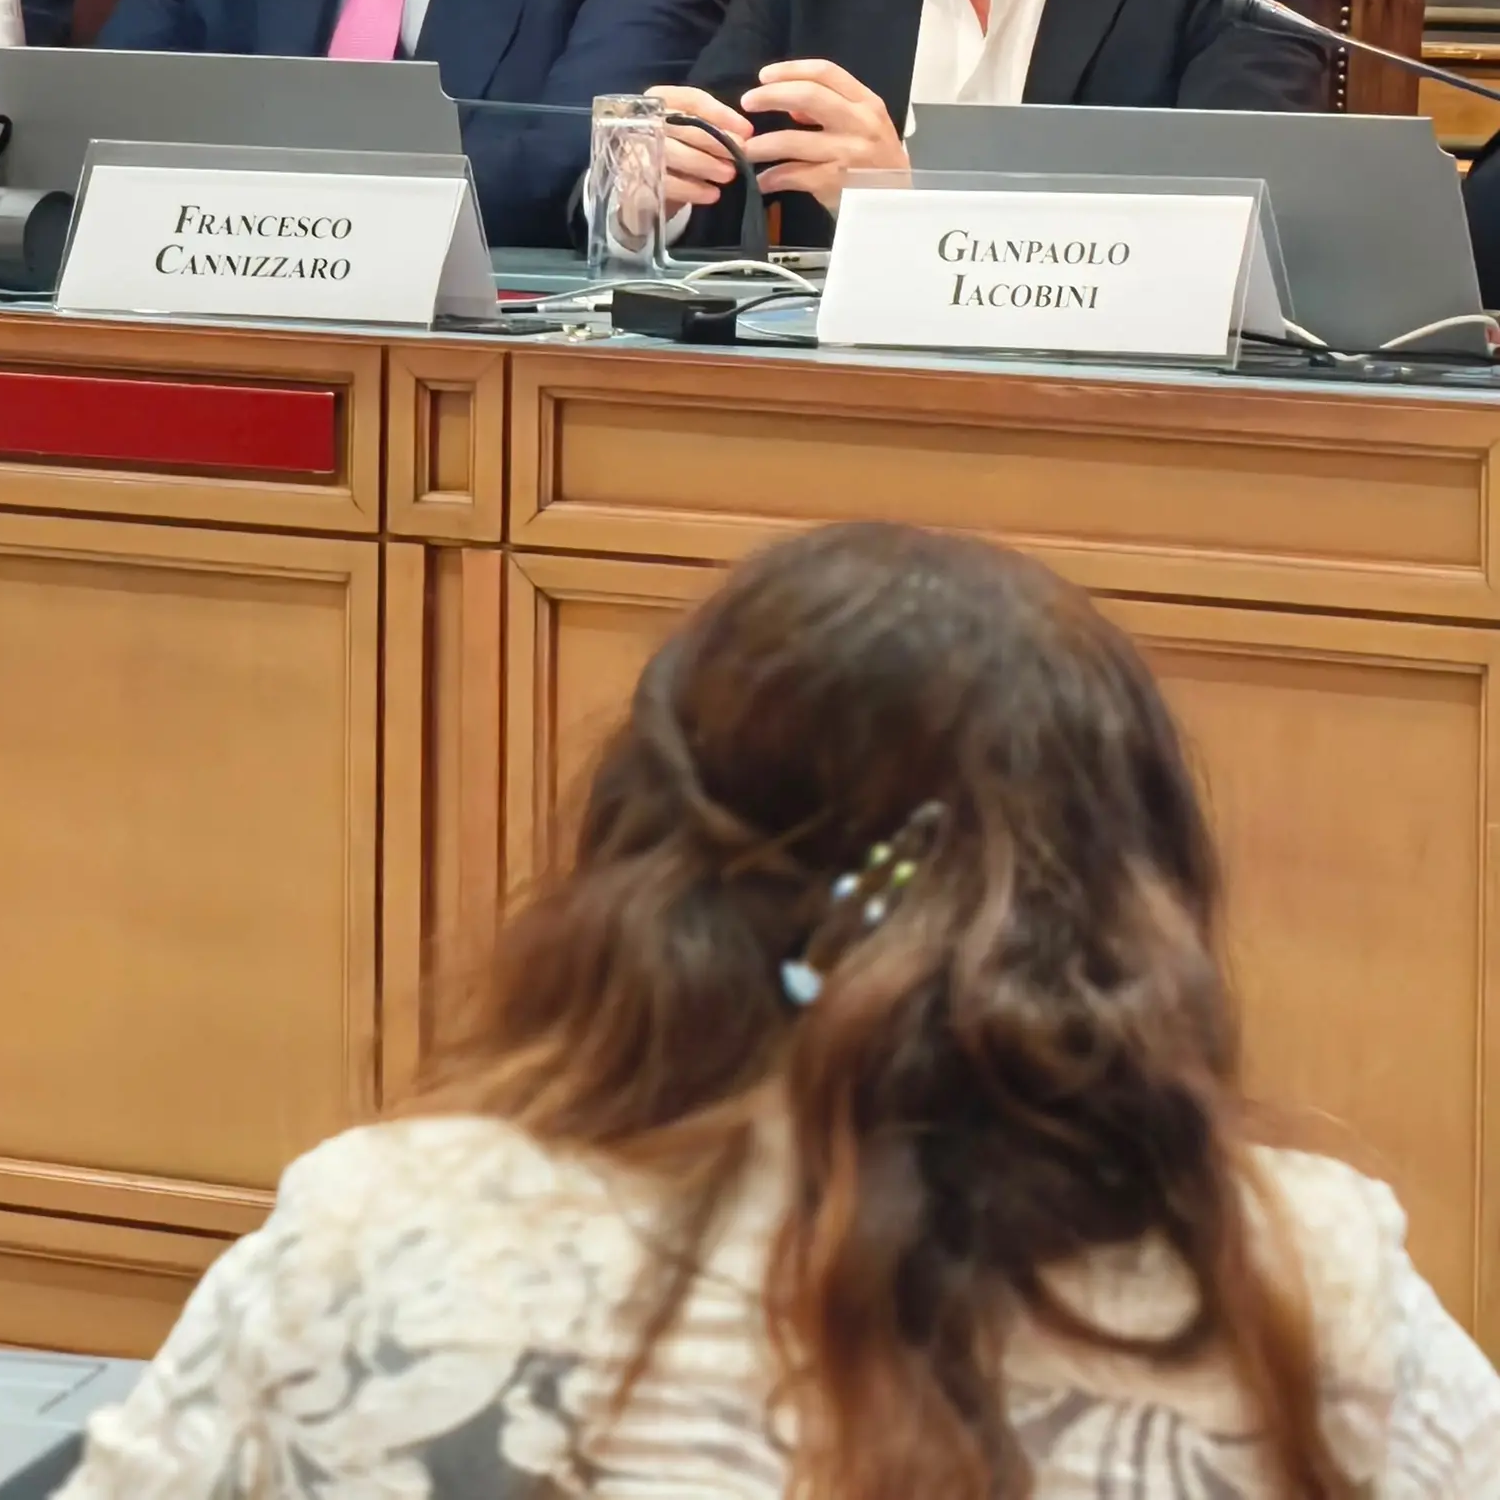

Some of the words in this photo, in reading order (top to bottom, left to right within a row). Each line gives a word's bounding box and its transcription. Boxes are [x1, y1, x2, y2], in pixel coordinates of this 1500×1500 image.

[174, 204, 353, 240] FRANCESCO
[155, 243, 352, 281] CANNIZZARO
[937, 230, 1131, 266] GIANPAOLO
[949, 273, 1099, 310] IACOBINI
